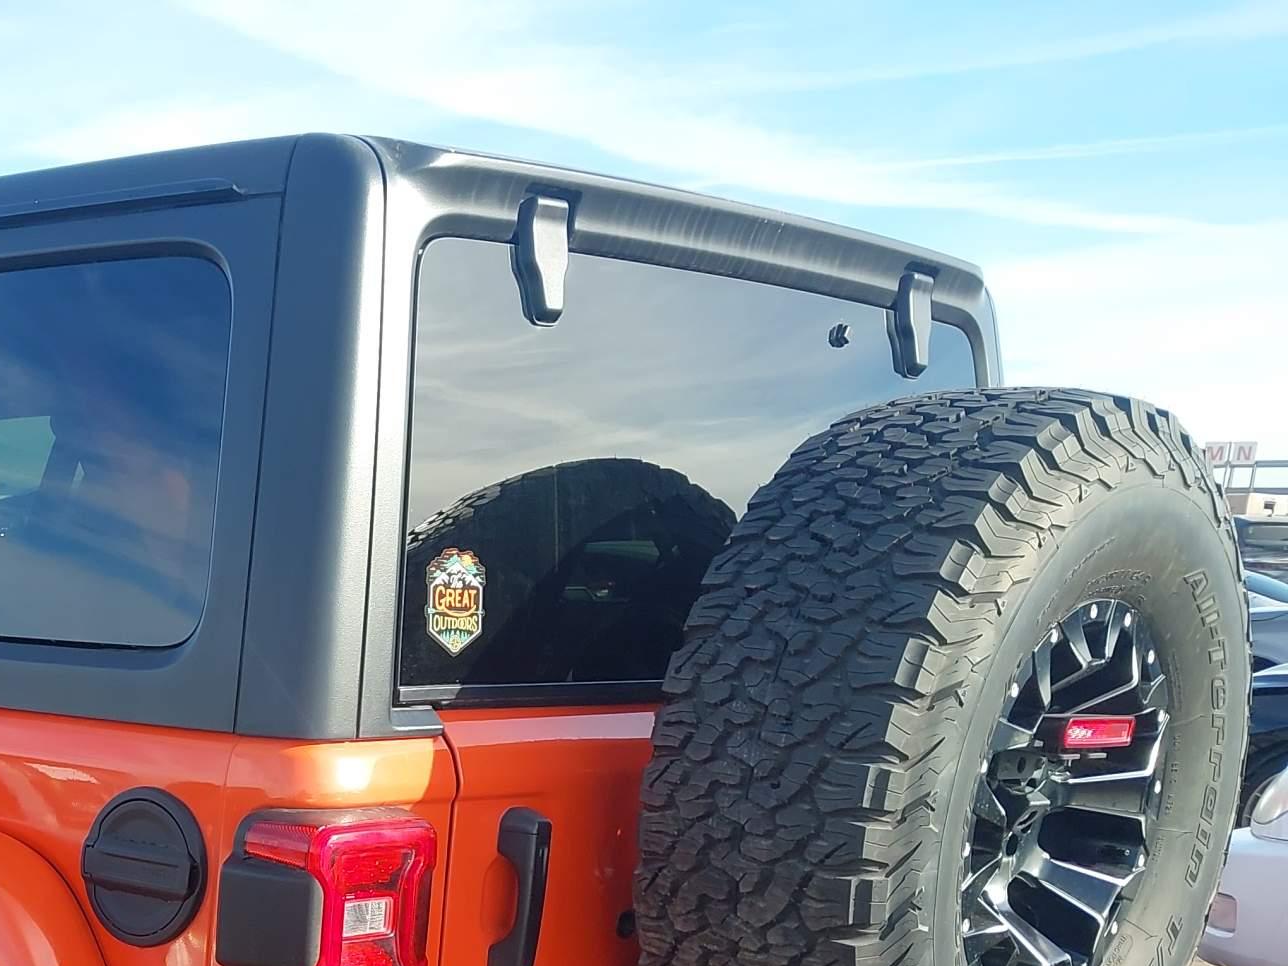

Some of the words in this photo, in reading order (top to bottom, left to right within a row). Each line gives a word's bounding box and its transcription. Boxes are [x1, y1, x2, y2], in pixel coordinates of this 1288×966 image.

[1236, 446, 1253, 461] N
[435, 586, 477, 617] GREAT
[433, 615, 478, 632] OUTDOORS
[1183, 569, 1228, 888] All-Terrain
